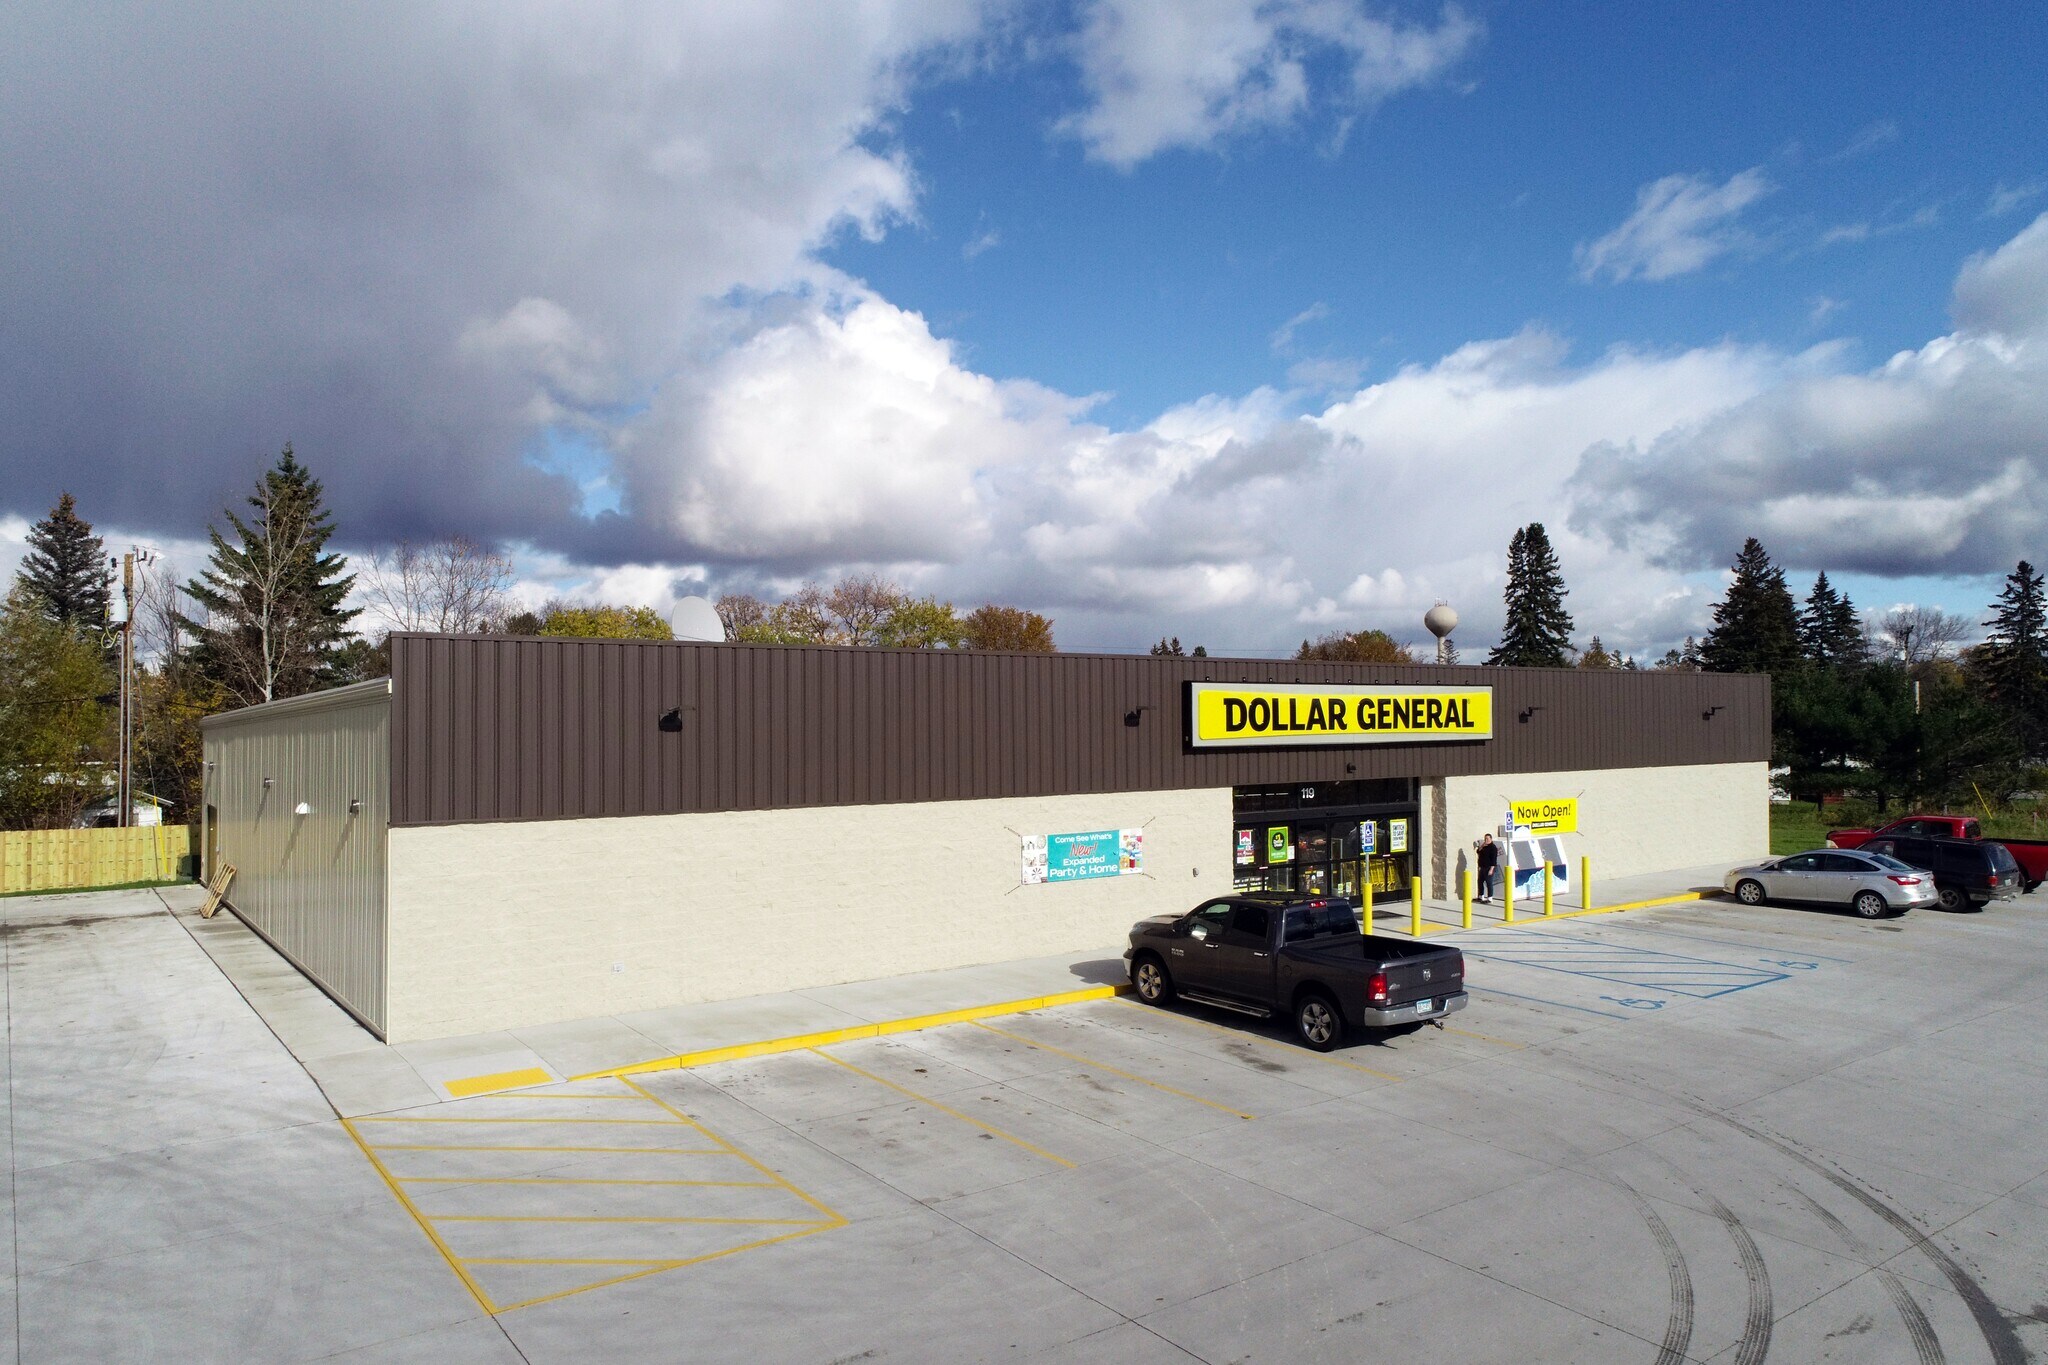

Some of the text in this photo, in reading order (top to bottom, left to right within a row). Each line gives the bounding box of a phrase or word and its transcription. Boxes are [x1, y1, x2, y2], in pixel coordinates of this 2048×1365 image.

[1223, 697, 1474, 732] DOLLAR GENERAL
[1301, 787, 1315, 799] 119
[1517, 803, 1571, 819] Now Open!
[1055, 836, 1075, 844] Come
[1090, 833, 1112, 841] What's
[1070, 842, 1098, 857] New!
[1063, 856, 1105, 866] Expanded
[1050, 864, 1118, 878] Party & Home
